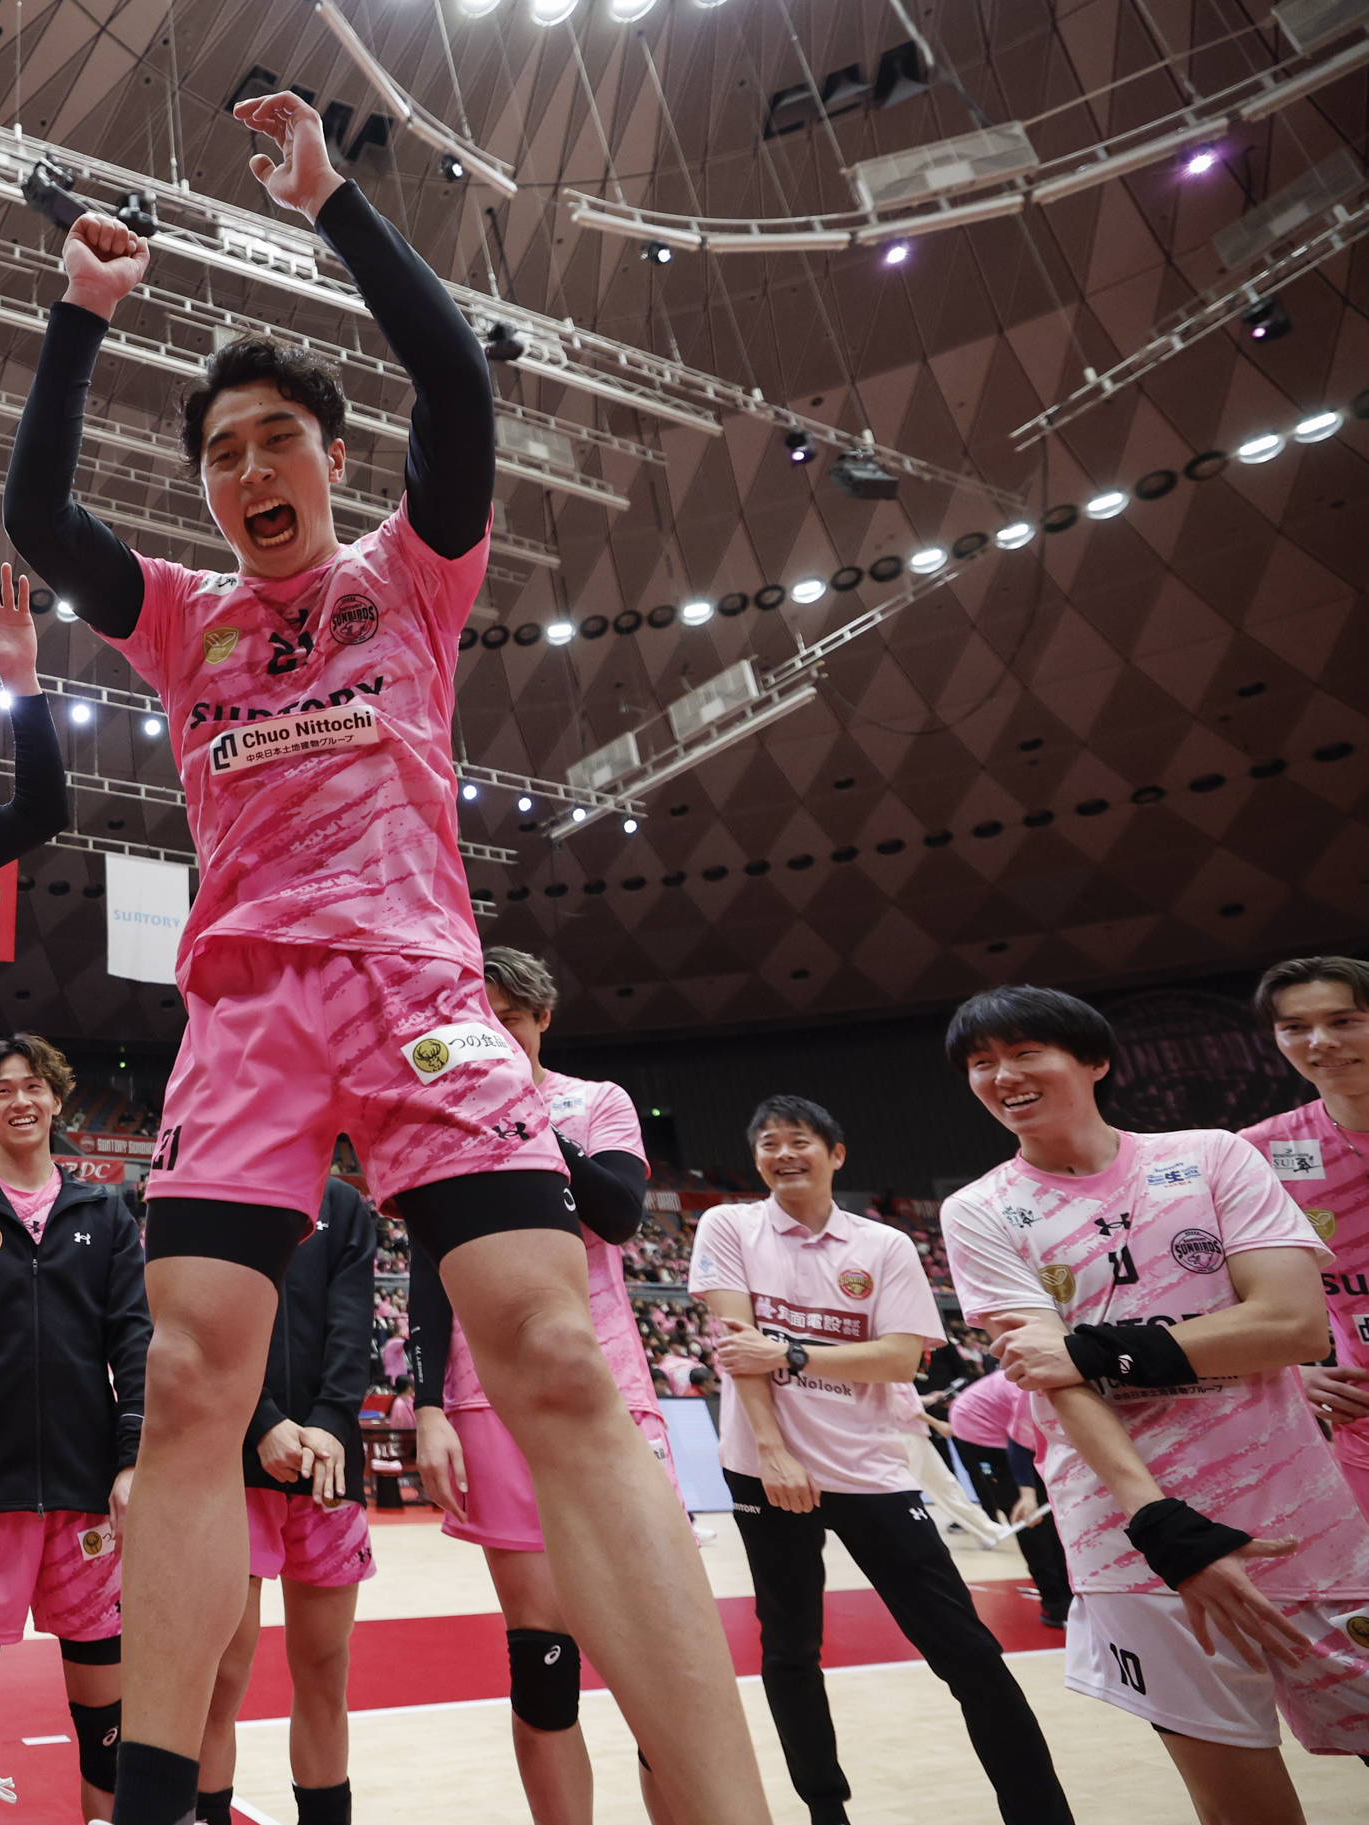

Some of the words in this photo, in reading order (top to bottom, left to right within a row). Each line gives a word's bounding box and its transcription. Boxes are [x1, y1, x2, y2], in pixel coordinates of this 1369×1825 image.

[332, 605, 375, 632] SUNBIRDS
[242, 728, 290, 749] Chuo
[295, 711, 372, 737] Nittochi
[246, 734, 354, 763] 中央日本土地建物グループ
[113, 909, 180, 929] SUNTORY
[447, 1033, 509, 1050] つの食品
[152, 1125, 182, 1171] 21
[1174, 1240, 1221, 1260] SUNBIRDS
[776, 1304, 842, 1334] 箕面電設
[796, 1375, 853, 1397] Nolook
[735, 1502, 762, 1515] NTORY
[1109, 1642, 1147, 1696] 10
